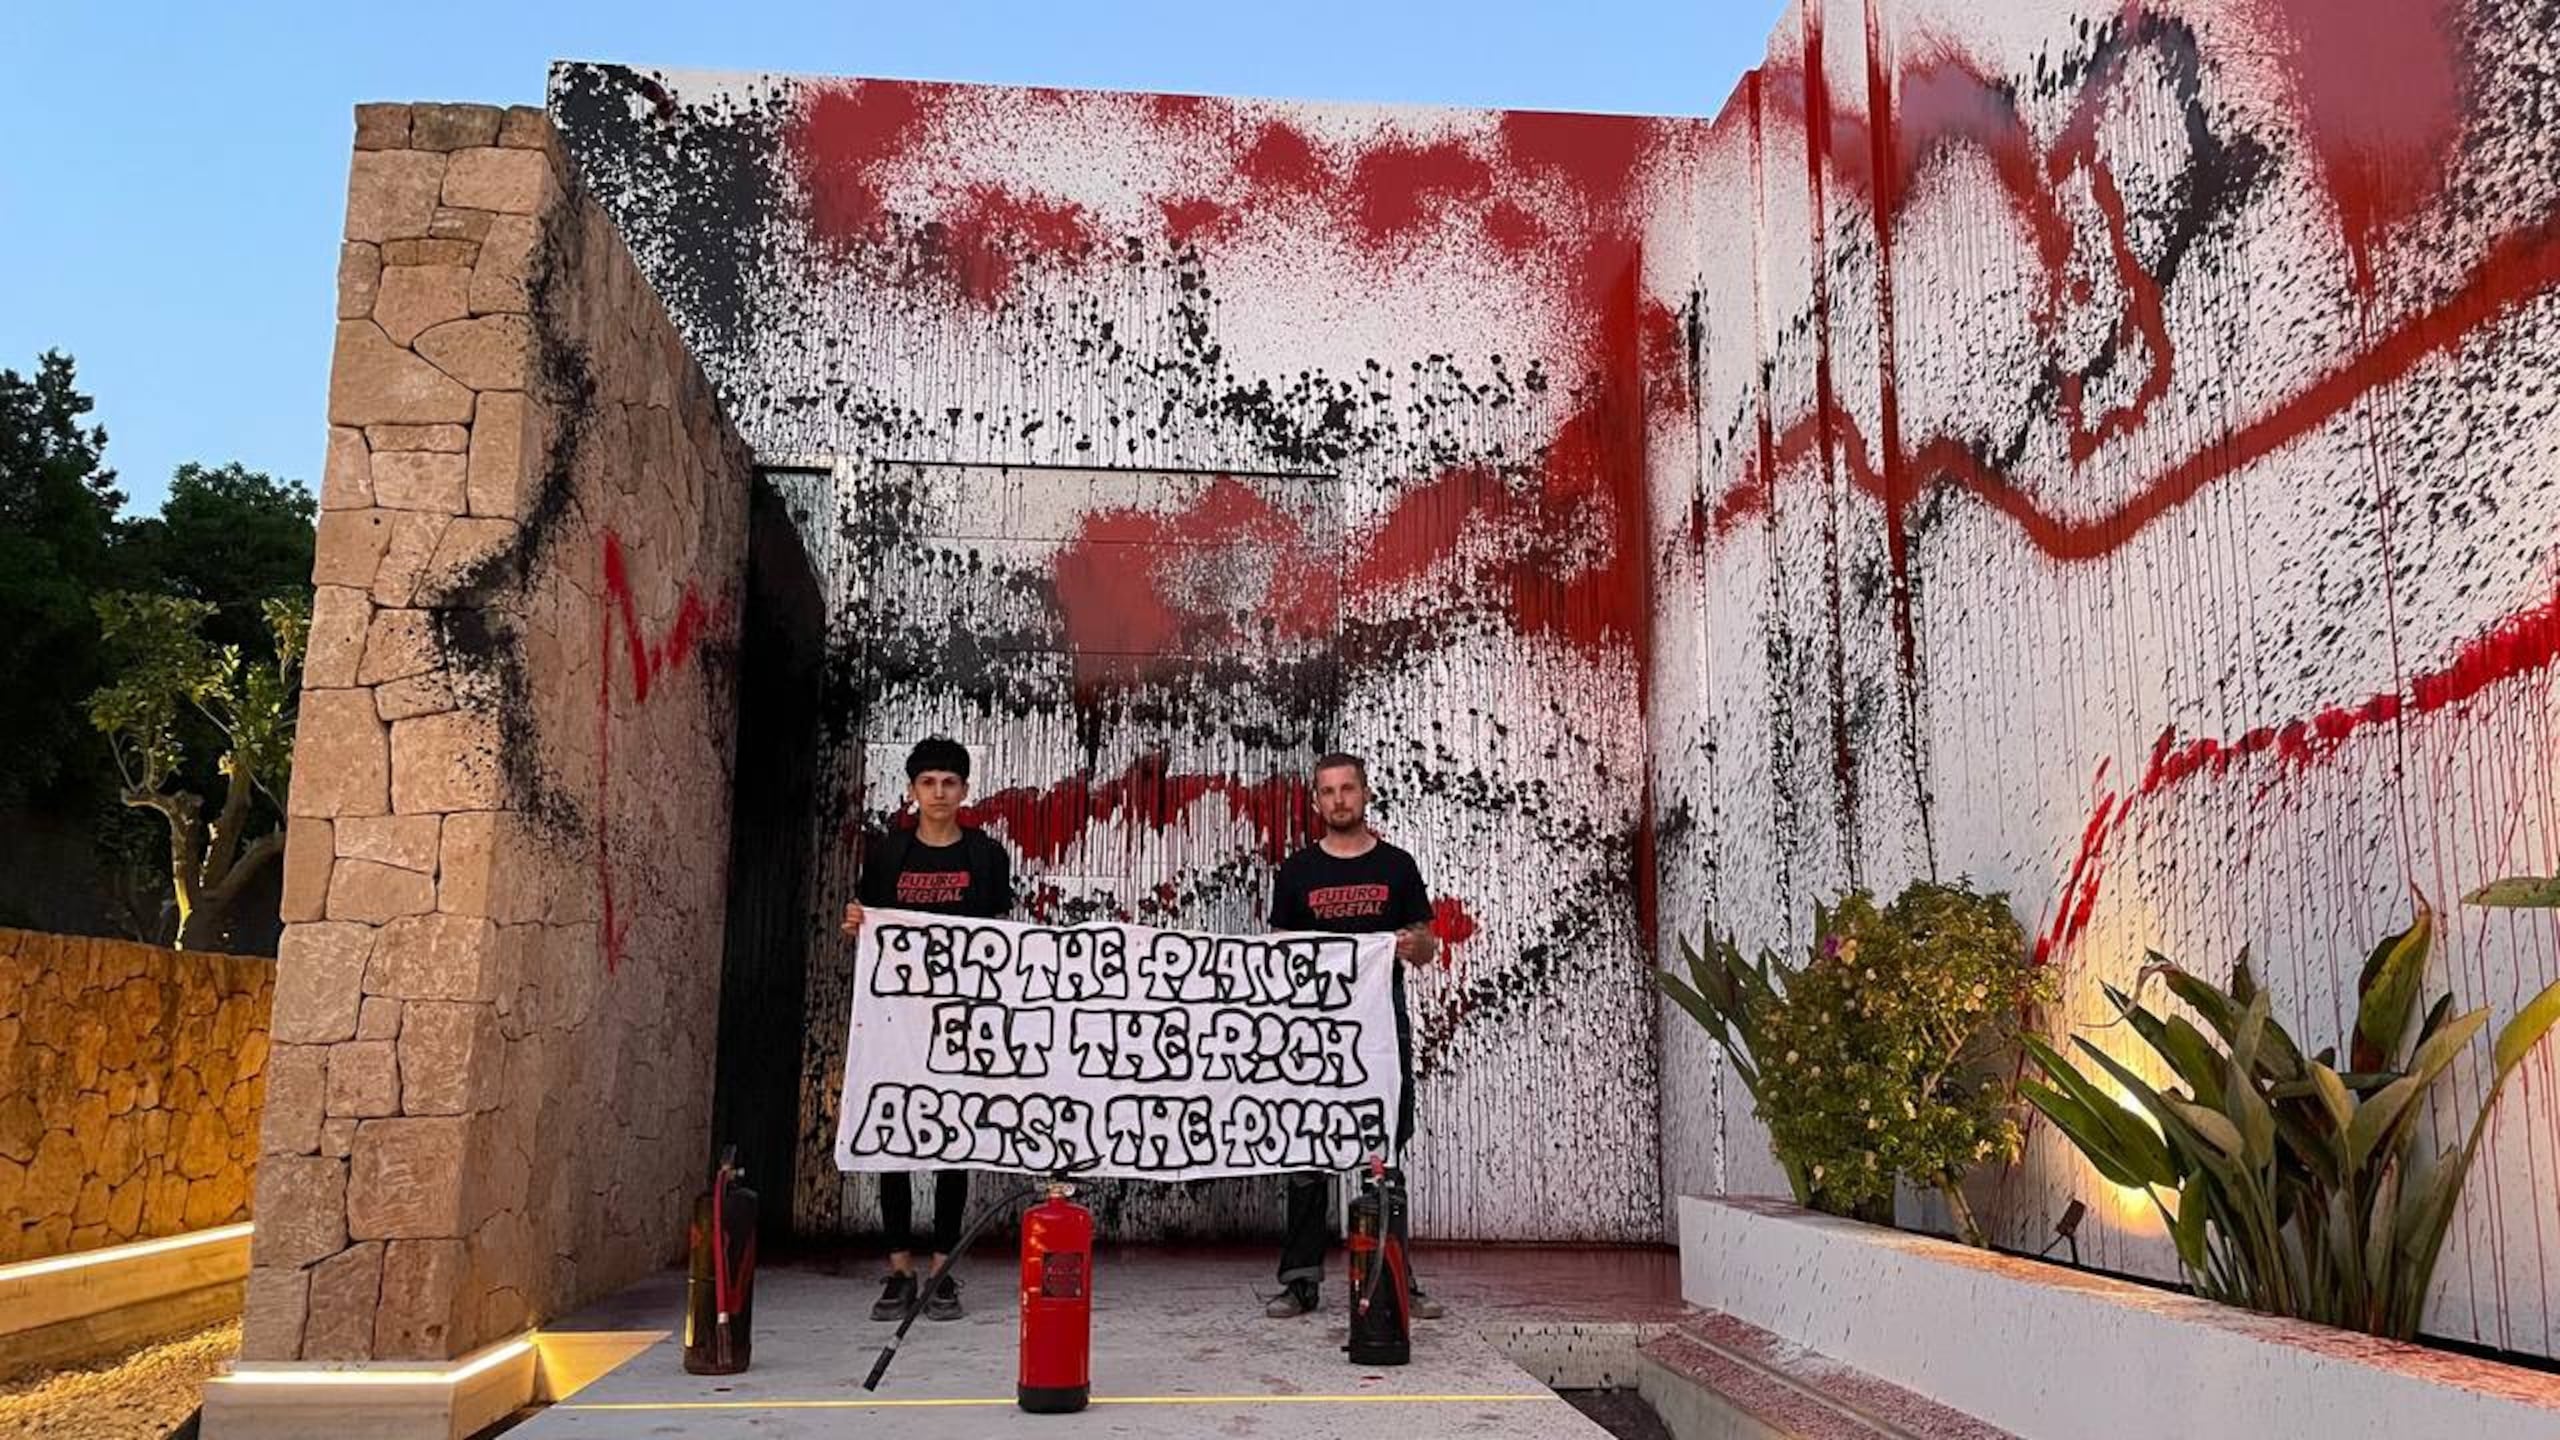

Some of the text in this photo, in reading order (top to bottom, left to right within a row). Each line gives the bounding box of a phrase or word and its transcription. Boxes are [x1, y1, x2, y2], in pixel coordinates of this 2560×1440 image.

[896, 888, 962, 902] VEGETAL
[1313, 901, 1382, 918] VEGETAL
[1316, 887, 1381, 901] FUTURO
[871, 926, 1357, 1008] HELP THE PLANET
[927, 1000, 1053, 1078] EAT
[1070, 1008, 1192, 1081] THE
[1105, 1095, 1217, 1169] THE
